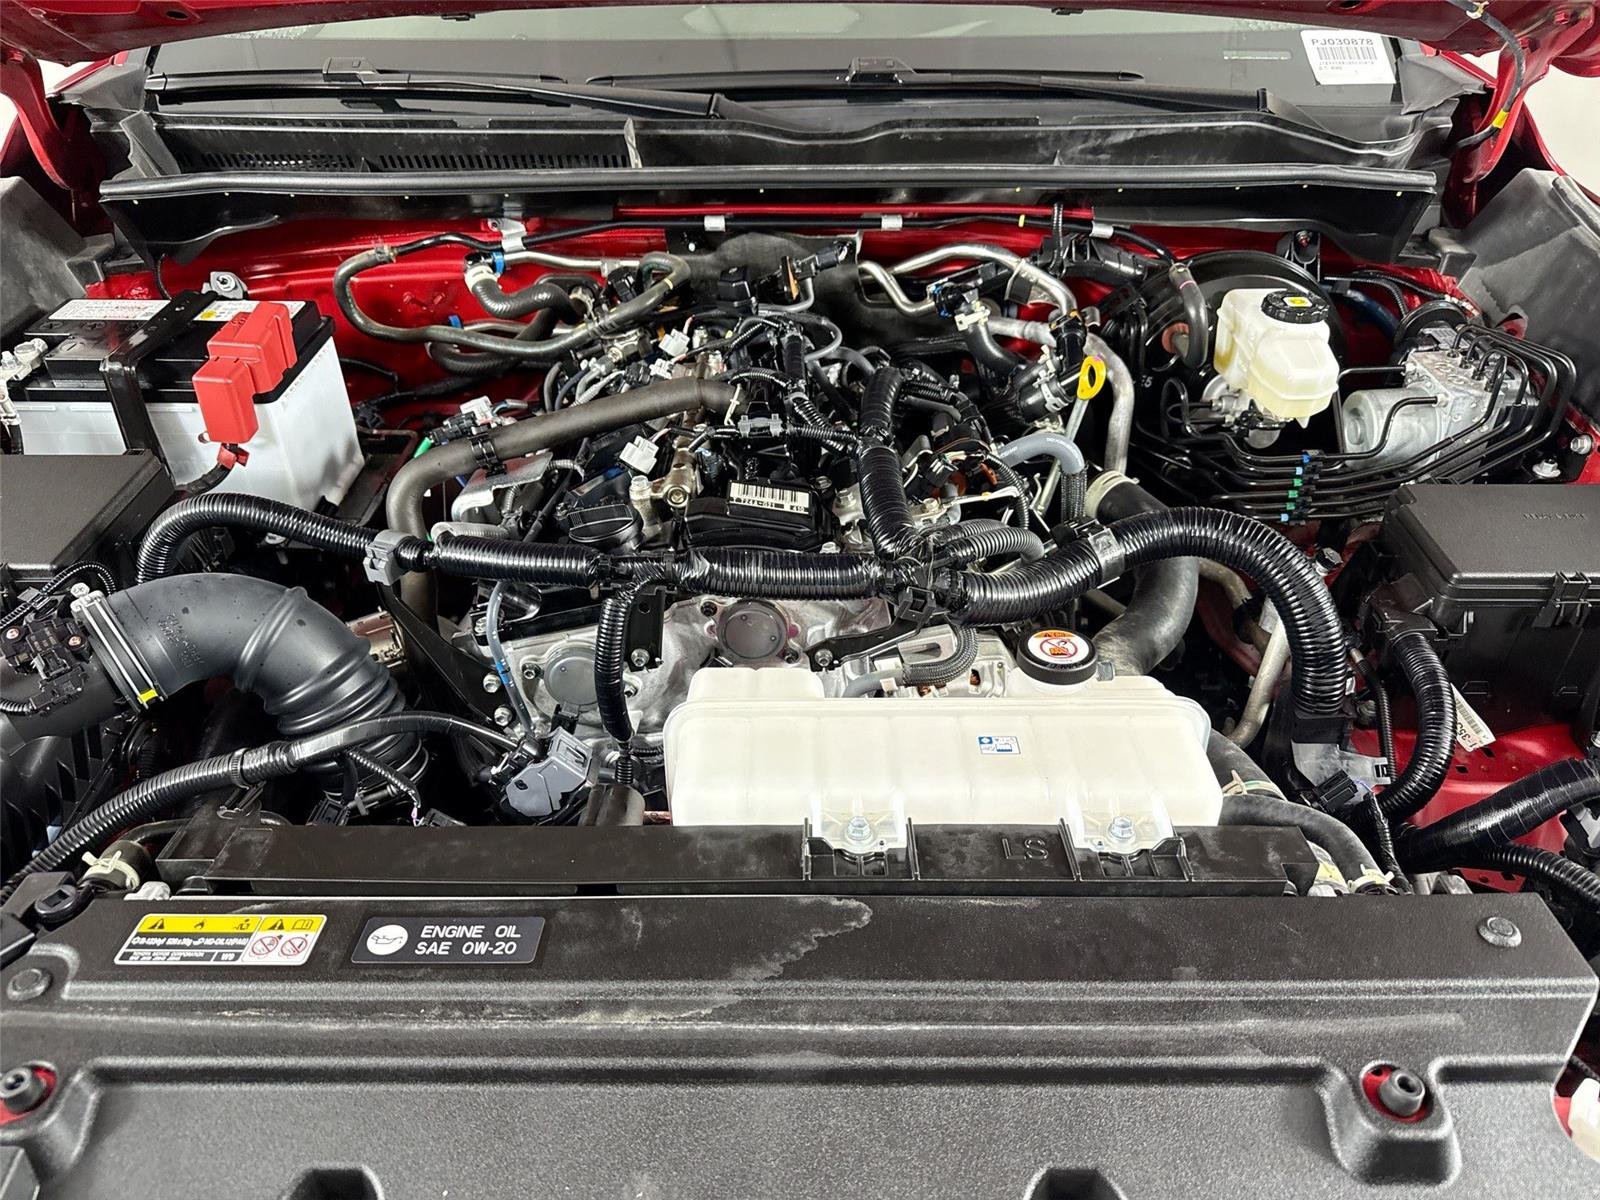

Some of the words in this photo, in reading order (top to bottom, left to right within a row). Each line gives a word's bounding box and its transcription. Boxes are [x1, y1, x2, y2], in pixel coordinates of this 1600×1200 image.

[1311, 38, 1374, 46] PJ030878
[1001, 837, 1049, 860] LS
[420, 925, 485, 938] ENGINE
[494, 925, 521, 938] OIL
[414, 942, 452, 955] SAE
[462, 942, 517, 955] 0W-20
